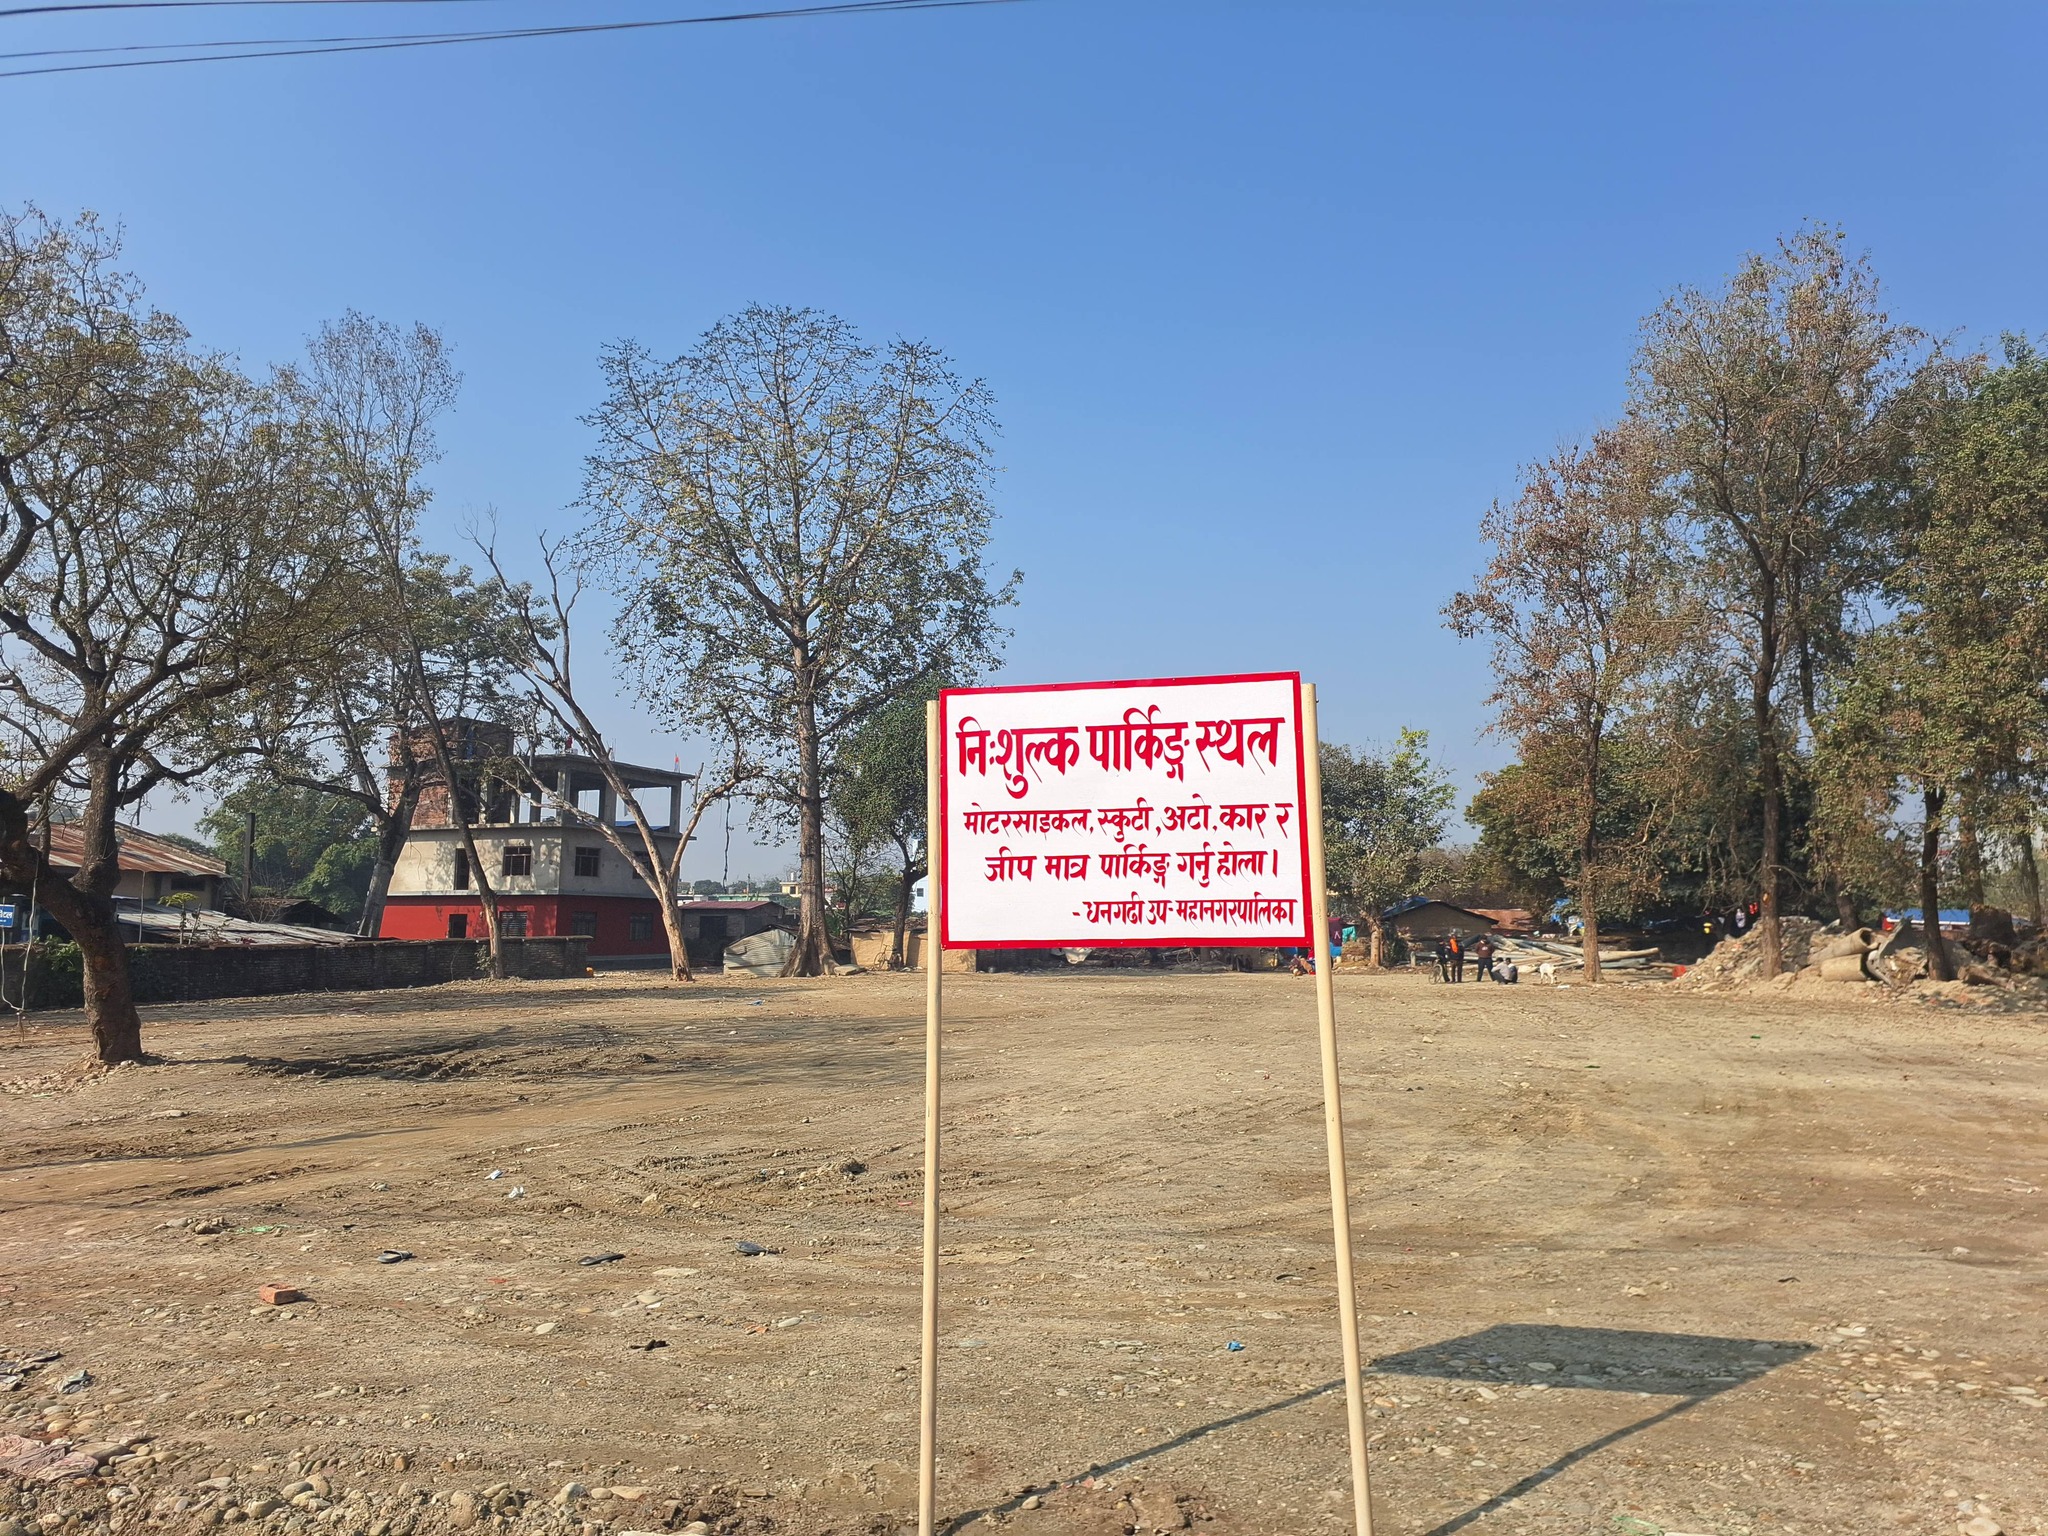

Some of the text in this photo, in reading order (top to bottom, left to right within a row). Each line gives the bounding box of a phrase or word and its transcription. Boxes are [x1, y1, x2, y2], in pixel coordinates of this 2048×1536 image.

[955, 716, 1080, 799] निःशुल्क
[1195, 717, 1286, 774] स्थल
[1219, 803, 1270, 836] कार
[1275, 803, 1294, 838] र
[984, 846, 1037, 882] जीप
[1044, 854, 1091, 880] मात्र
[1176, 841, 1216, 888] गर्नु
